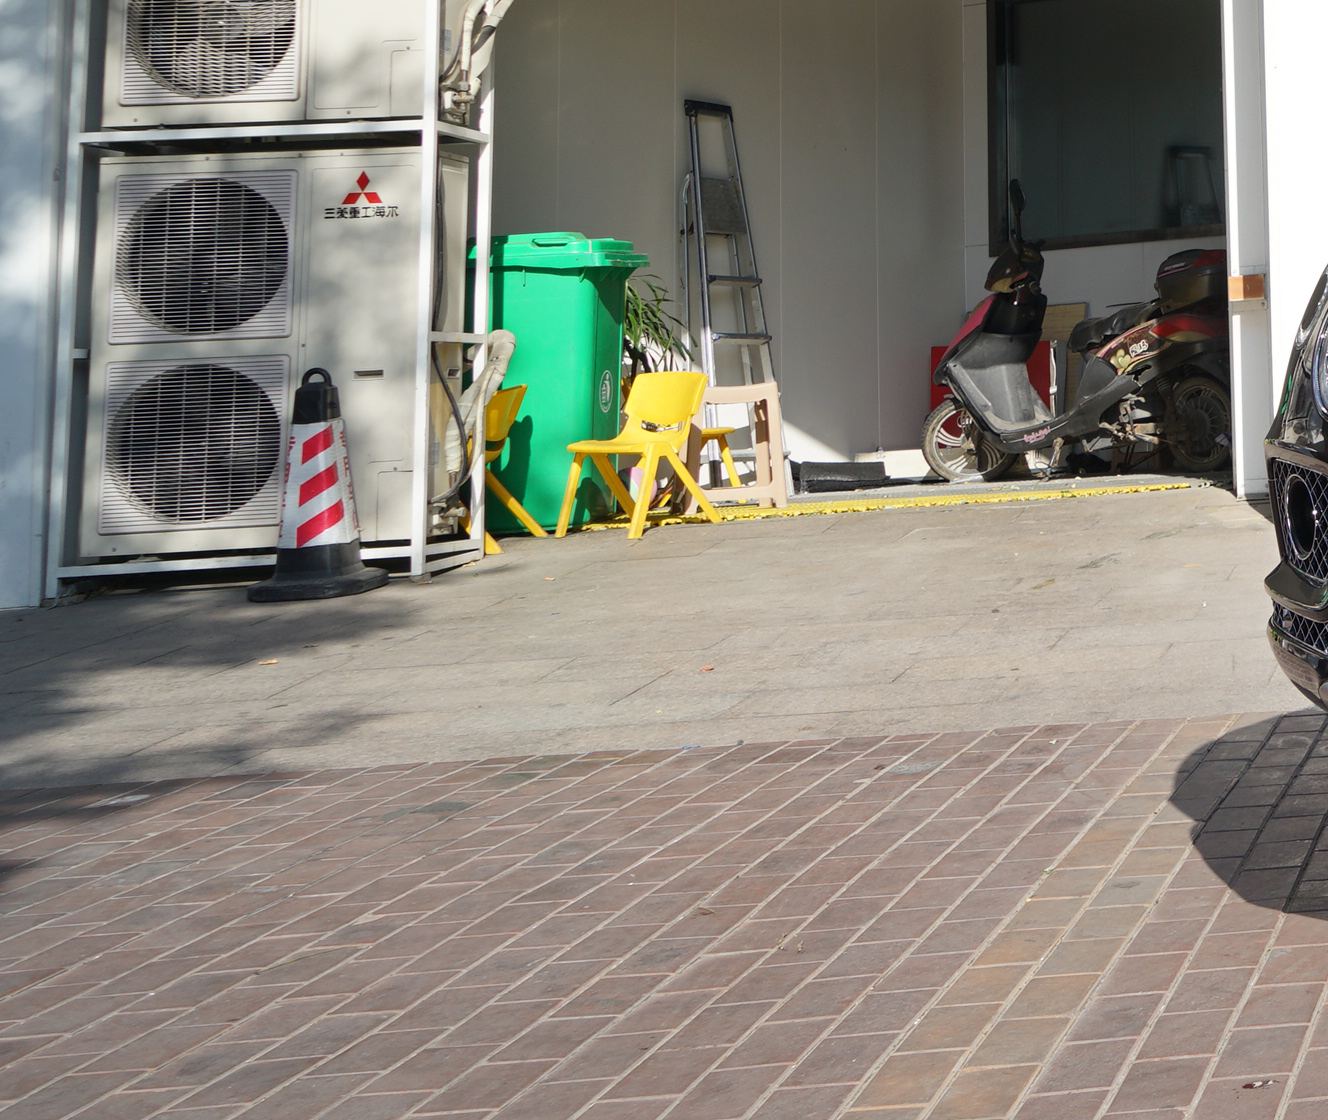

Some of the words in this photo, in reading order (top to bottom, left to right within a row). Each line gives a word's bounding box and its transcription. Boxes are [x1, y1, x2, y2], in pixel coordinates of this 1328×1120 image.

[324, 206, 399, 220] 三菱重工海尔
